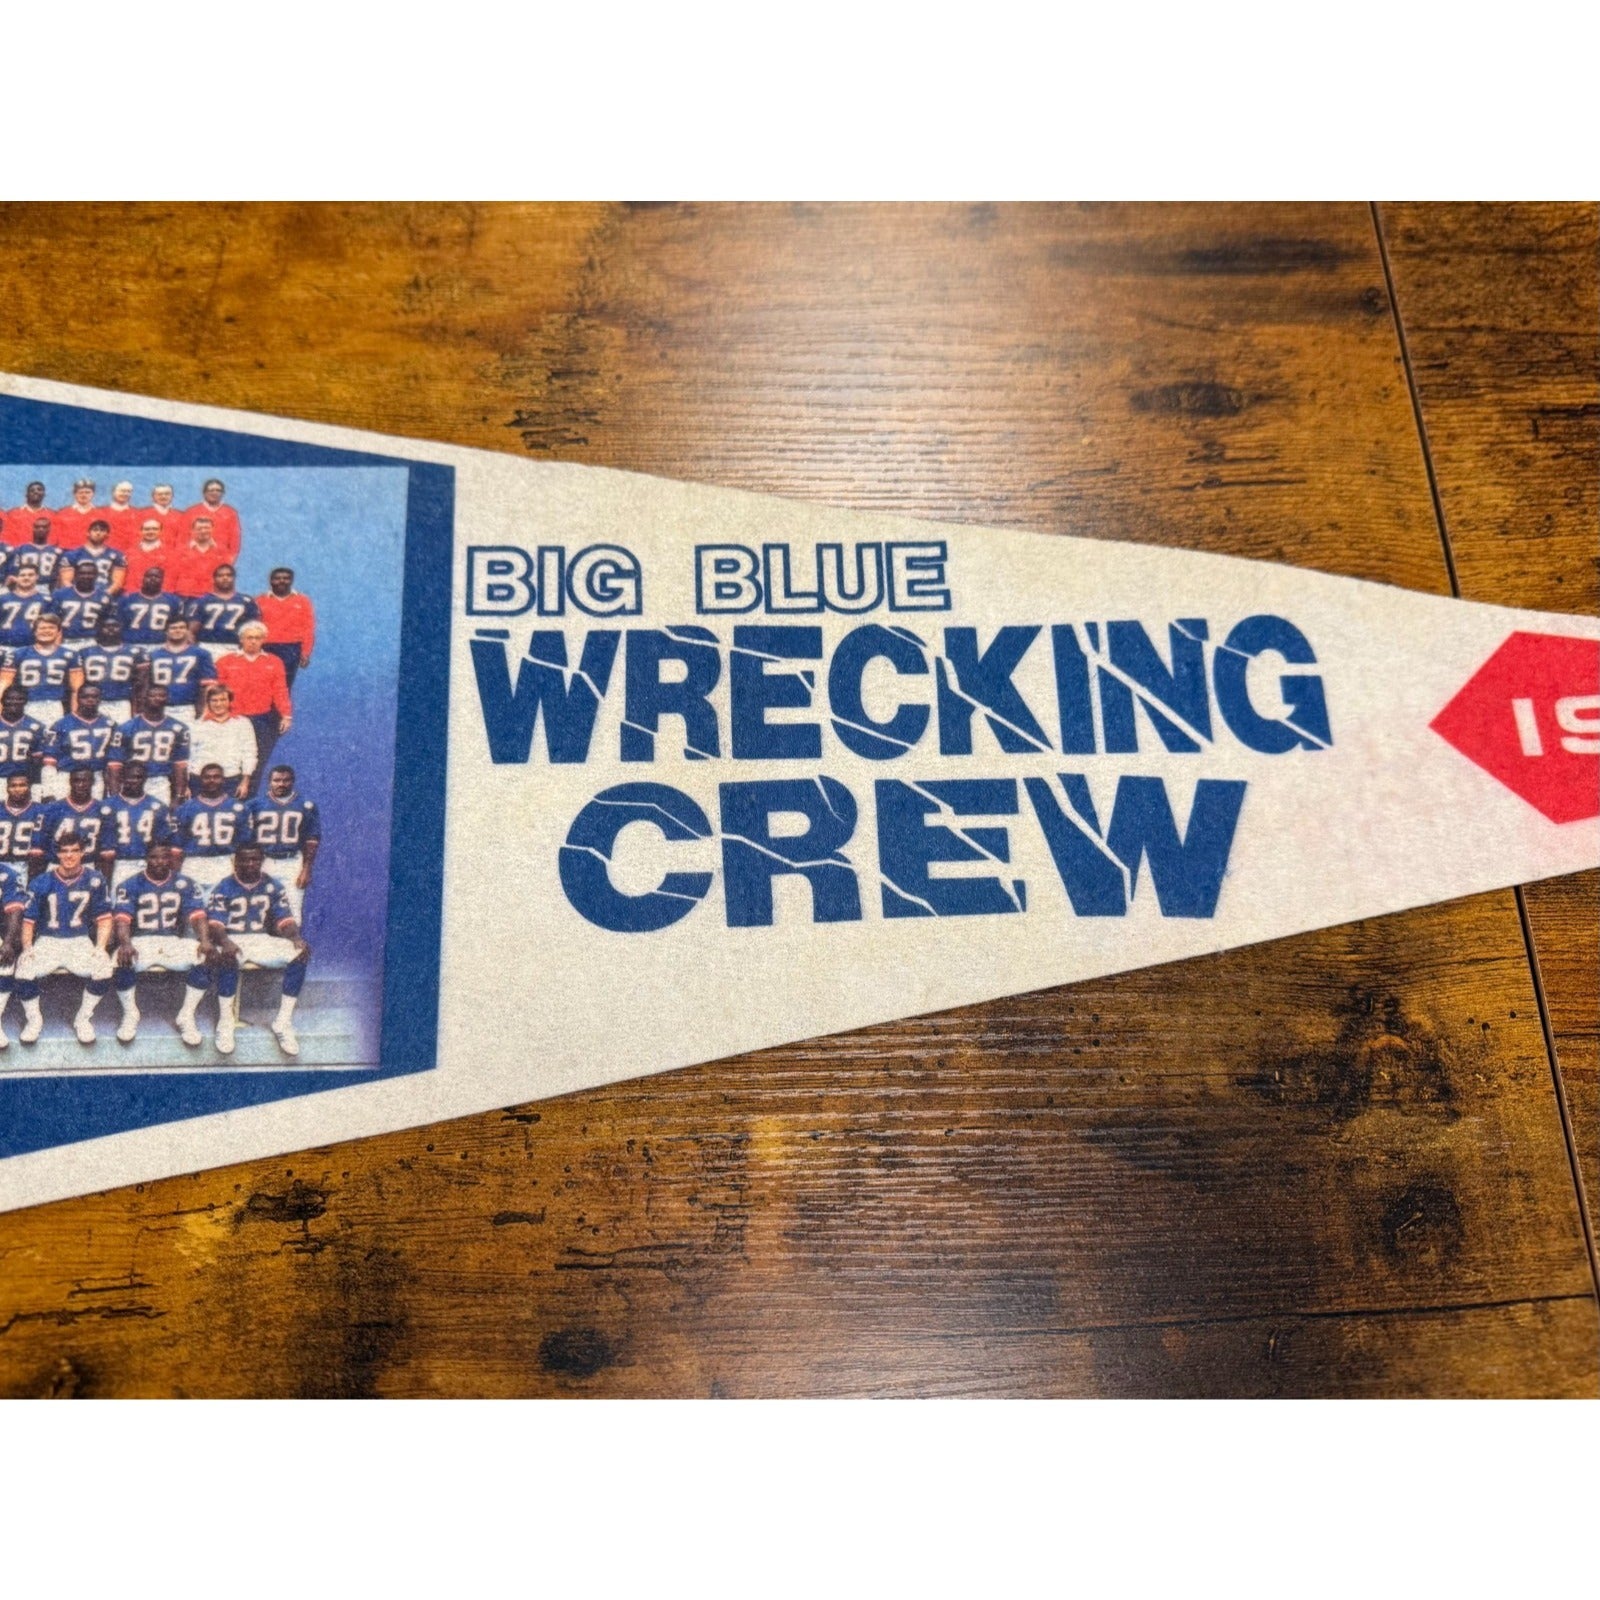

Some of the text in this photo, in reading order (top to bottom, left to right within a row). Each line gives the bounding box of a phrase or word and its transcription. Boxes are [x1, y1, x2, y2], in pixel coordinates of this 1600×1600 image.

[466, 541, 952, 617] BIG BLUE
[1, 601, 43, 630] 74
[61, 600, 102, 628] 75
[129, 603, 171, 630] 76
[204, 603, 246, 630] 77
[20, 659, 68, 686] 65
[85, 655, 133, 682] 66
[153, 655, 197, 686] 67
[469, 614, 1333, 764] WRECKING
[69, 727, 112, 760] 57
[132, 730, 176, 762] 58
[55, 818, 101, 853] 43
[116, 809, 154, 844] 14
[191, 811, 236, 846] 46
[257, 810, 303, 844] 20
[558, 772, 1248, 933] CREW
[47, 890, 90, 929] 17
[137, 891, 181, 930] 22
[227, 894, 271, 932] 23
